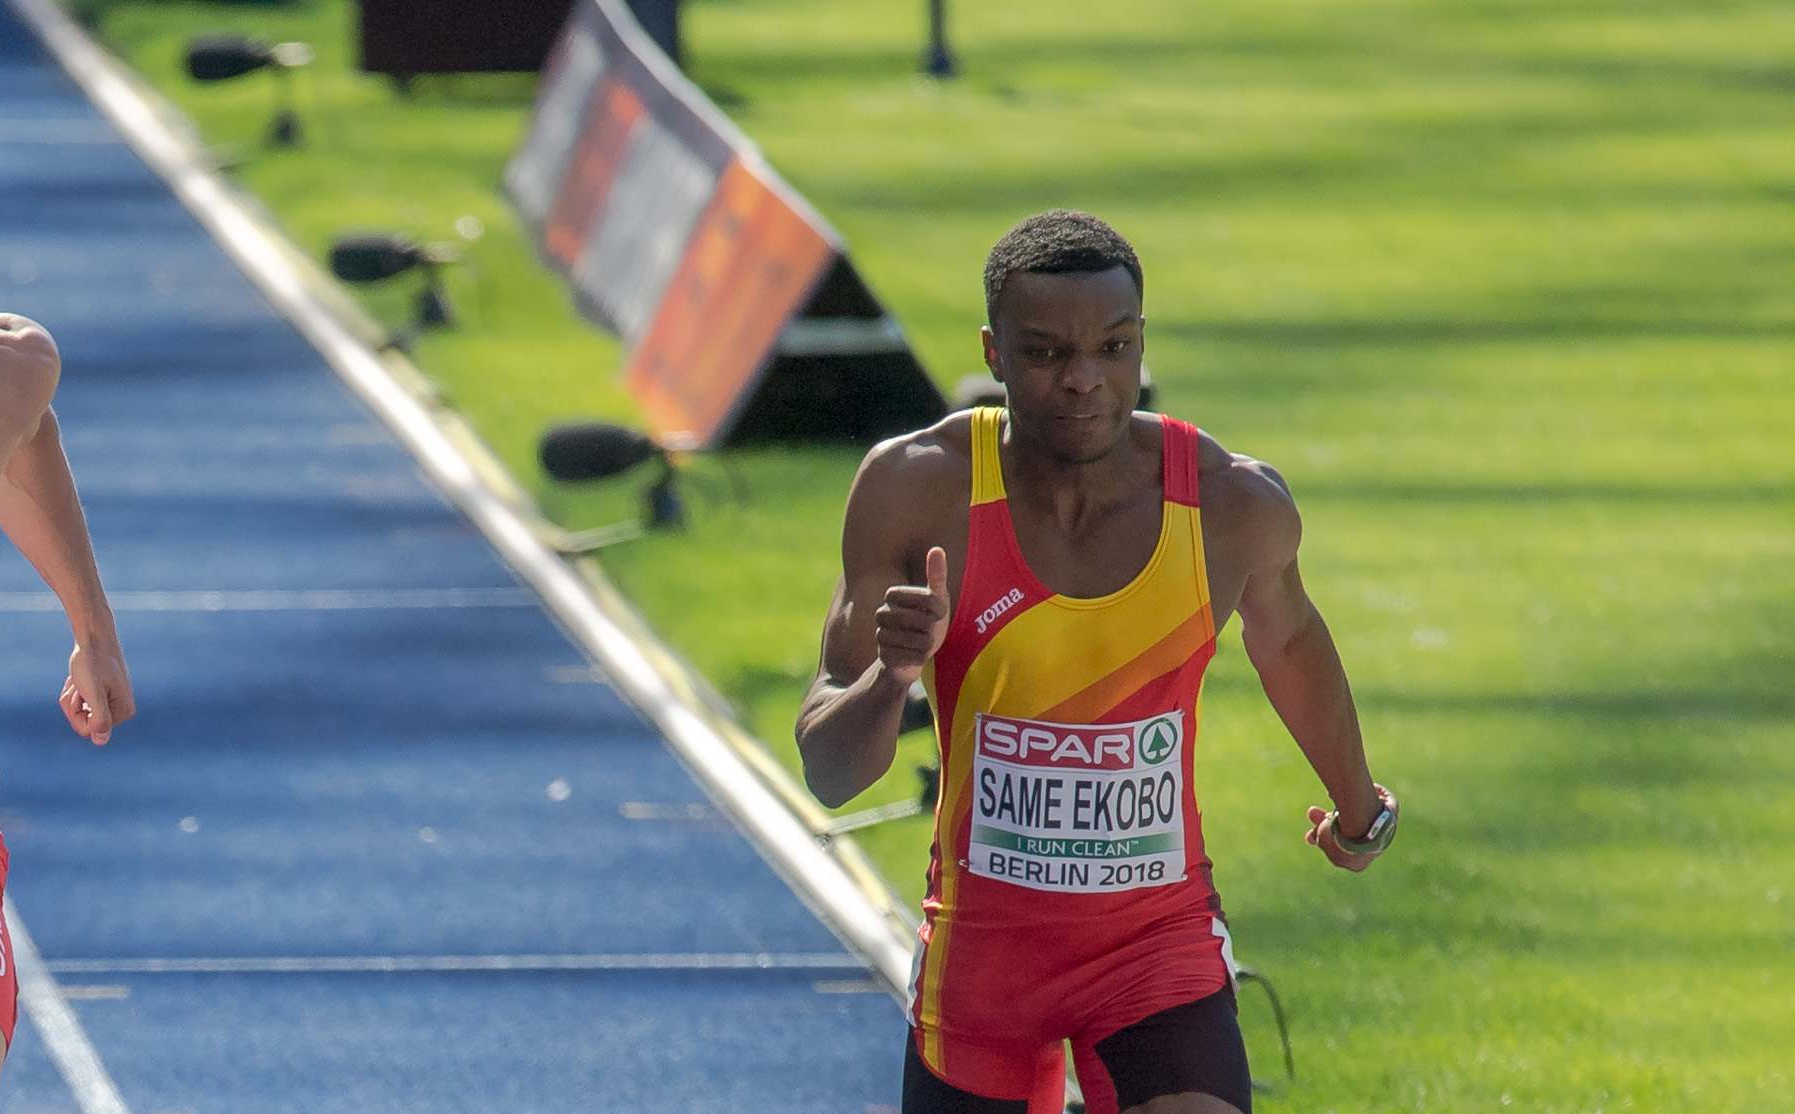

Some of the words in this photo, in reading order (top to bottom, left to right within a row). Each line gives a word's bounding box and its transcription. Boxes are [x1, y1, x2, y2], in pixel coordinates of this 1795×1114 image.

[983, 721, 1131, 765] SPAR
[979, 767, 1064, 830] SAME
[1073, 771, 1176, 832] EKOBO
[1027, 839, 1066, 855] RUN
[989, 852, 1090, 887] BERLIN
[1099, 860, 1166, 887] 2018
